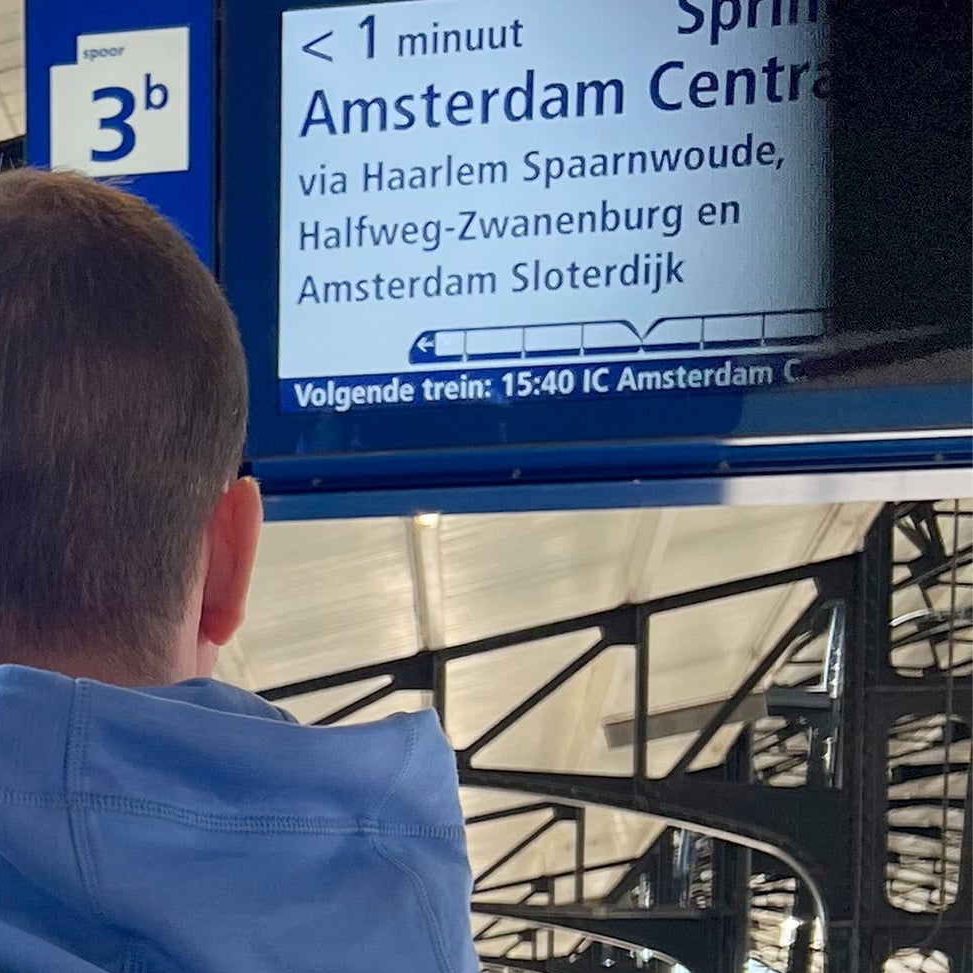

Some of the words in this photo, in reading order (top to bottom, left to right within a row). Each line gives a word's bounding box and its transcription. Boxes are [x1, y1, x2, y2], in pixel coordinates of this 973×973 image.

[82, 46, 125, 61] spoor
[358, 14, 376, 59] 1
[398, 19, 524, 57] minuut
[298, 69, 625, 138] Amsterdam
[299, 164, 348, 197] via
[363, 154, 508, 193] Haarlem
[522, 132, 784, 189] Spaarnwoude,
[299, 200, 683, 252] Halfweg-Zwanenburg
[698, 200, 740, 226] en
[297, 265, 497, 305] Amsterdam
[512, 251, 685, 294] Sloterdijk
[294, 376, 415, 412] Volgende
[421, 373, 492, 401] trein:
[501, 368, 575, 398] 15:40
[582, 367, 610, 394] IC
[615, 360, 773, 392] Amsterdam
